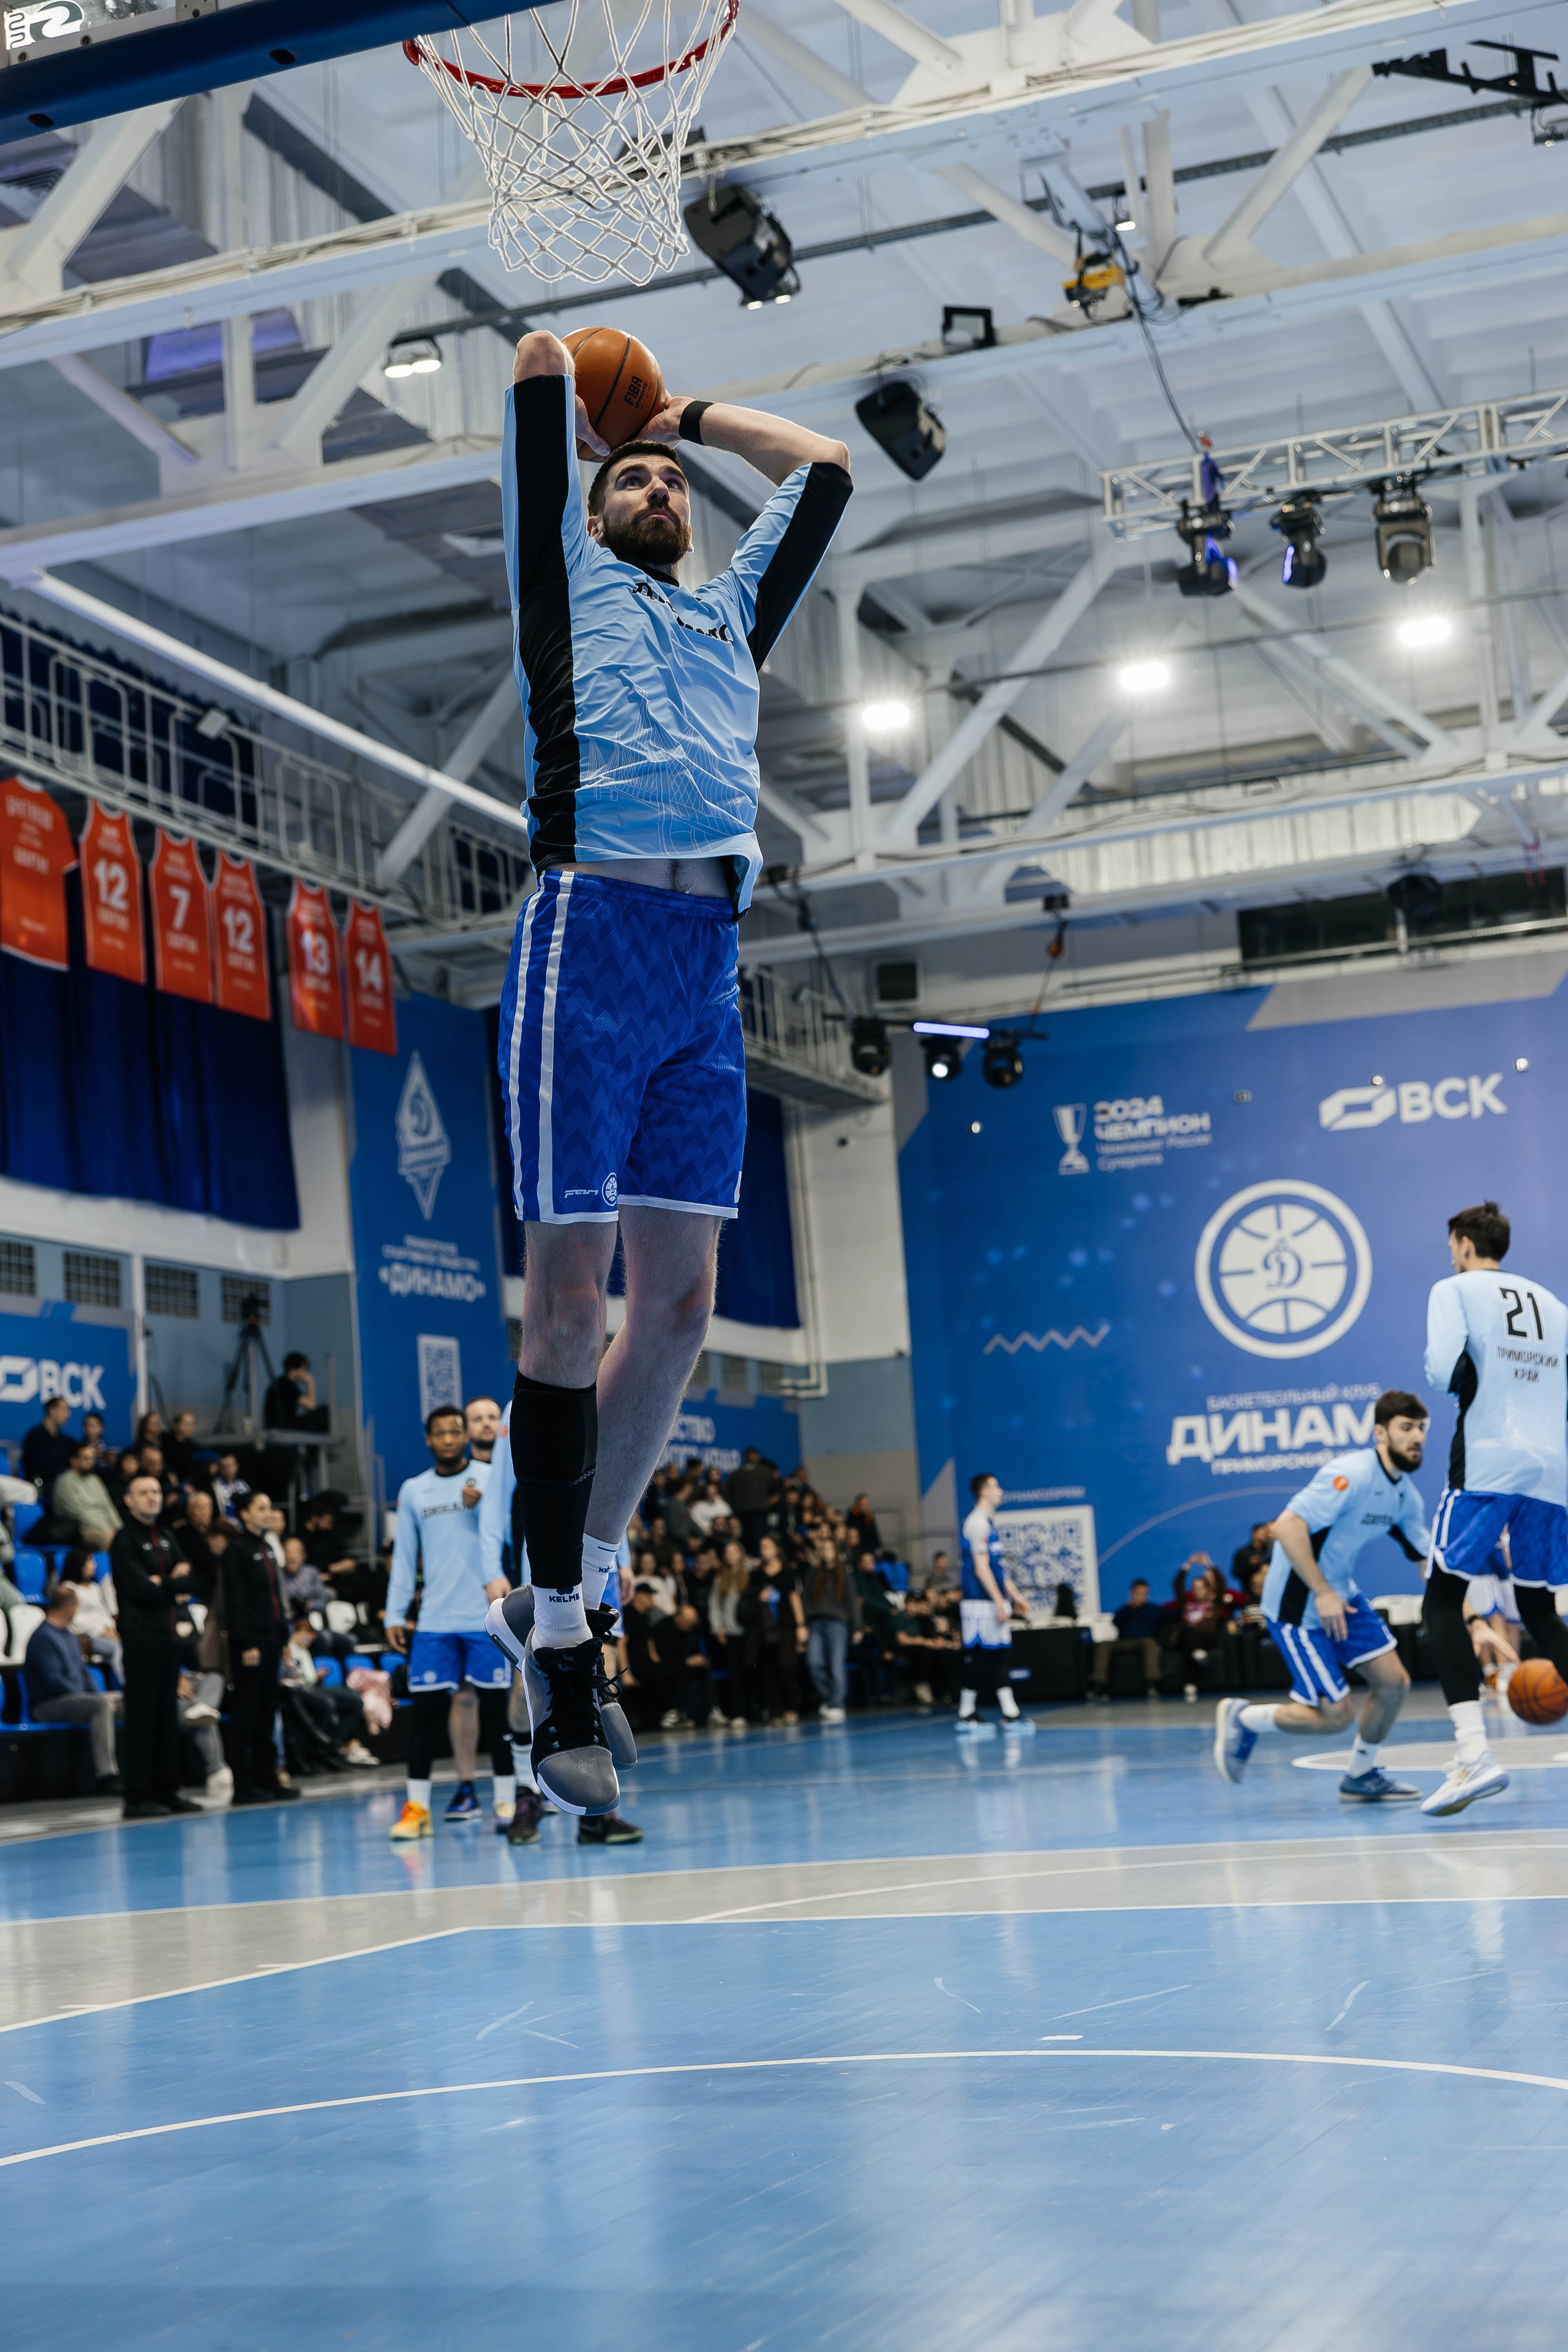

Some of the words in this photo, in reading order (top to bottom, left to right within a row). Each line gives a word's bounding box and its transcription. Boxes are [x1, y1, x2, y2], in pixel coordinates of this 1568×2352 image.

[623, 375, 643, 407] FIBA
[94, 858, 128, 912] 12
[169, 885, 190, 930] 7
[222, 904, 254, 954] 12
[301, 930, 331, 974] 13
[355, 951, 383, 994] 14
[1093, 1095, 1164, 1125] 2024
[1397, 1072, 1509, 1125] ВСК
[1093, 1112, 1212, 1142] ЧЕМПИОН
[1498, 1286, 1544, 1341] 21
[1166, 1401, 1377, 1466] ДИНАМ
[549, 1592, 581, 1603] KELME
